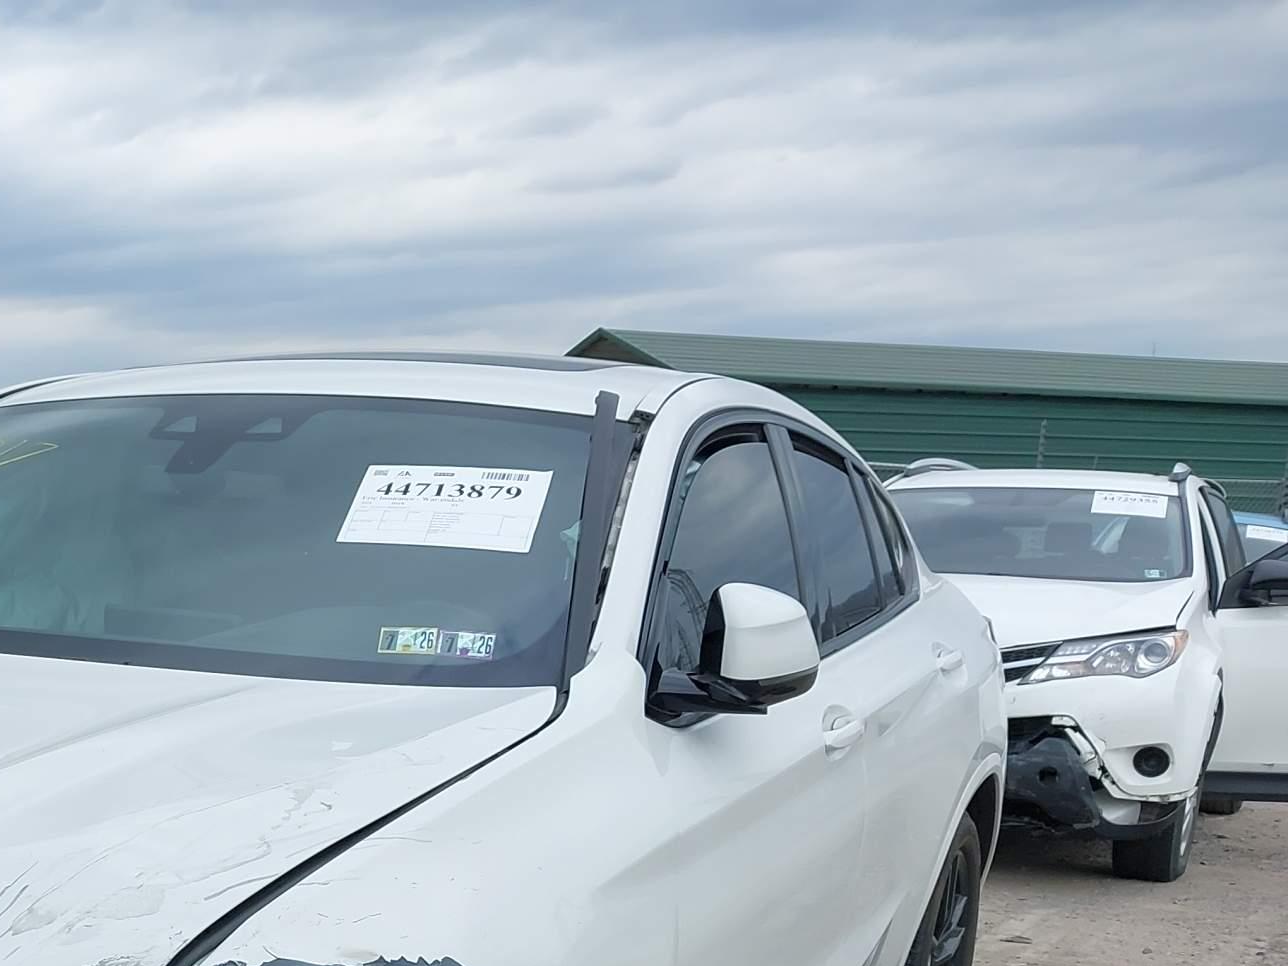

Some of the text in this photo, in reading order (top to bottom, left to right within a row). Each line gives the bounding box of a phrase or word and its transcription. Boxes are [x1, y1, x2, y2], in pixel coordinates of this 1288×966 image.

[376, 482, 523, 500] 44713879
[385, 631, 434, 650] 7 26
[447, 636, 493, 654] 7 26
